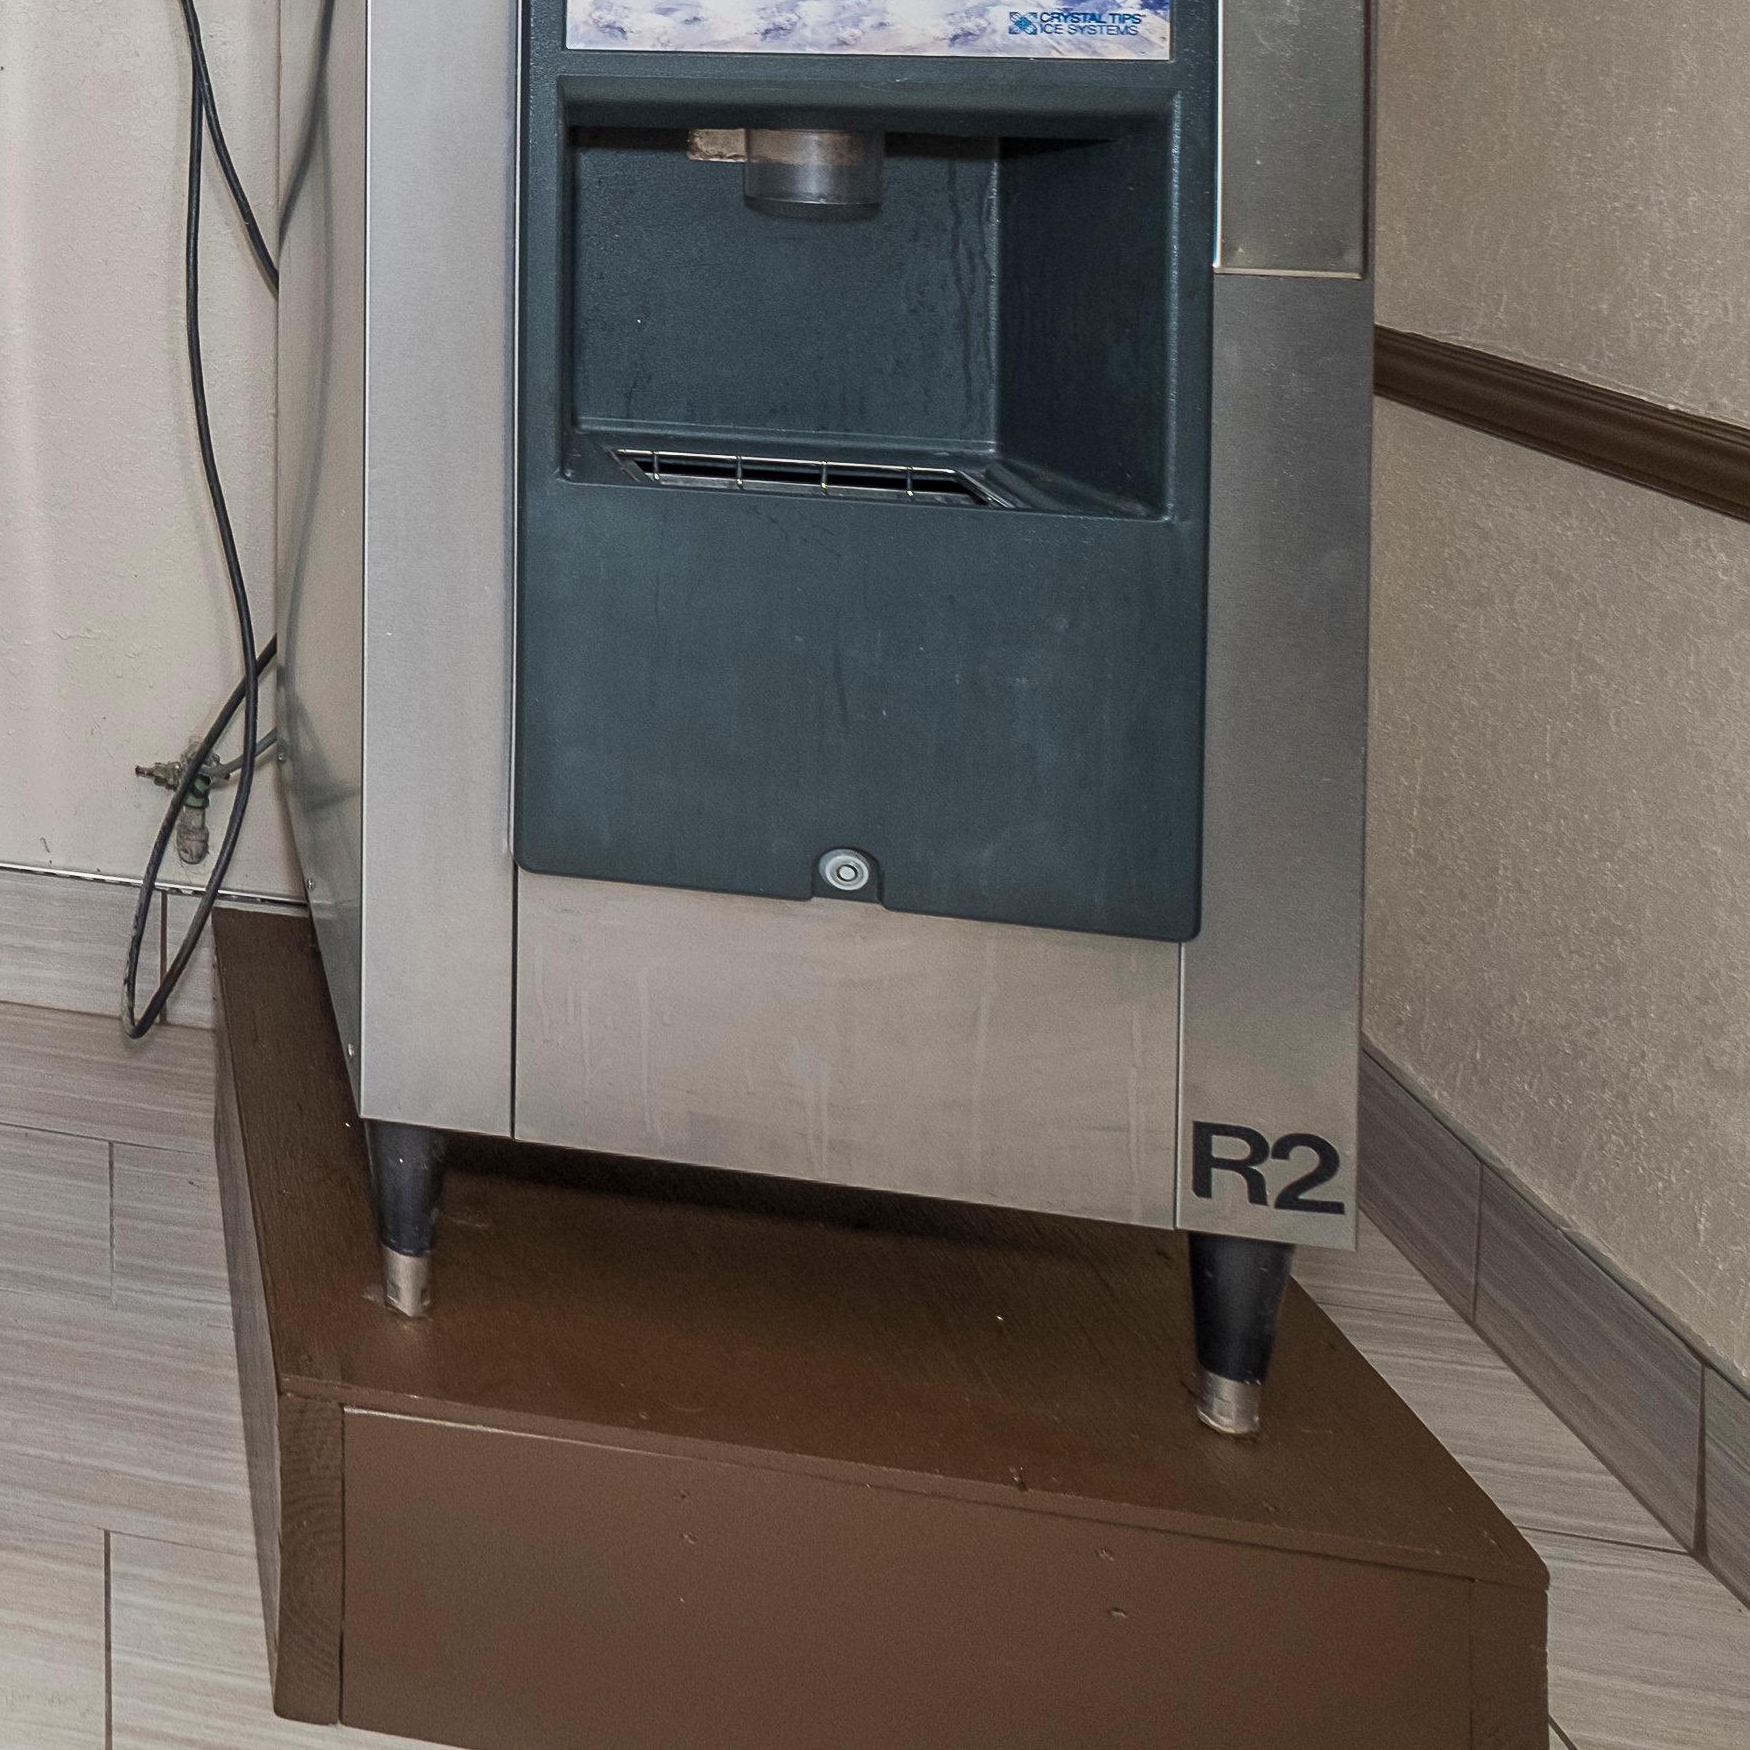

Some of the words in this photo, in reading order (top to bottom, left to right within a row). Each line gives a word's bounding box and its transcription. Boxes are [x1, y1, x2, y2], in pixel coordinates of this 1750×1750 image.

[1040, 12, 1106, 23] CRYSTAL
[1108, 13, 1143, 24] TIPS
[1040, 24, 1063, 34] ICE
[1067, 24, 1139, 35] SYSTEMS
[1192, 1120, 1346, 1215] R2
